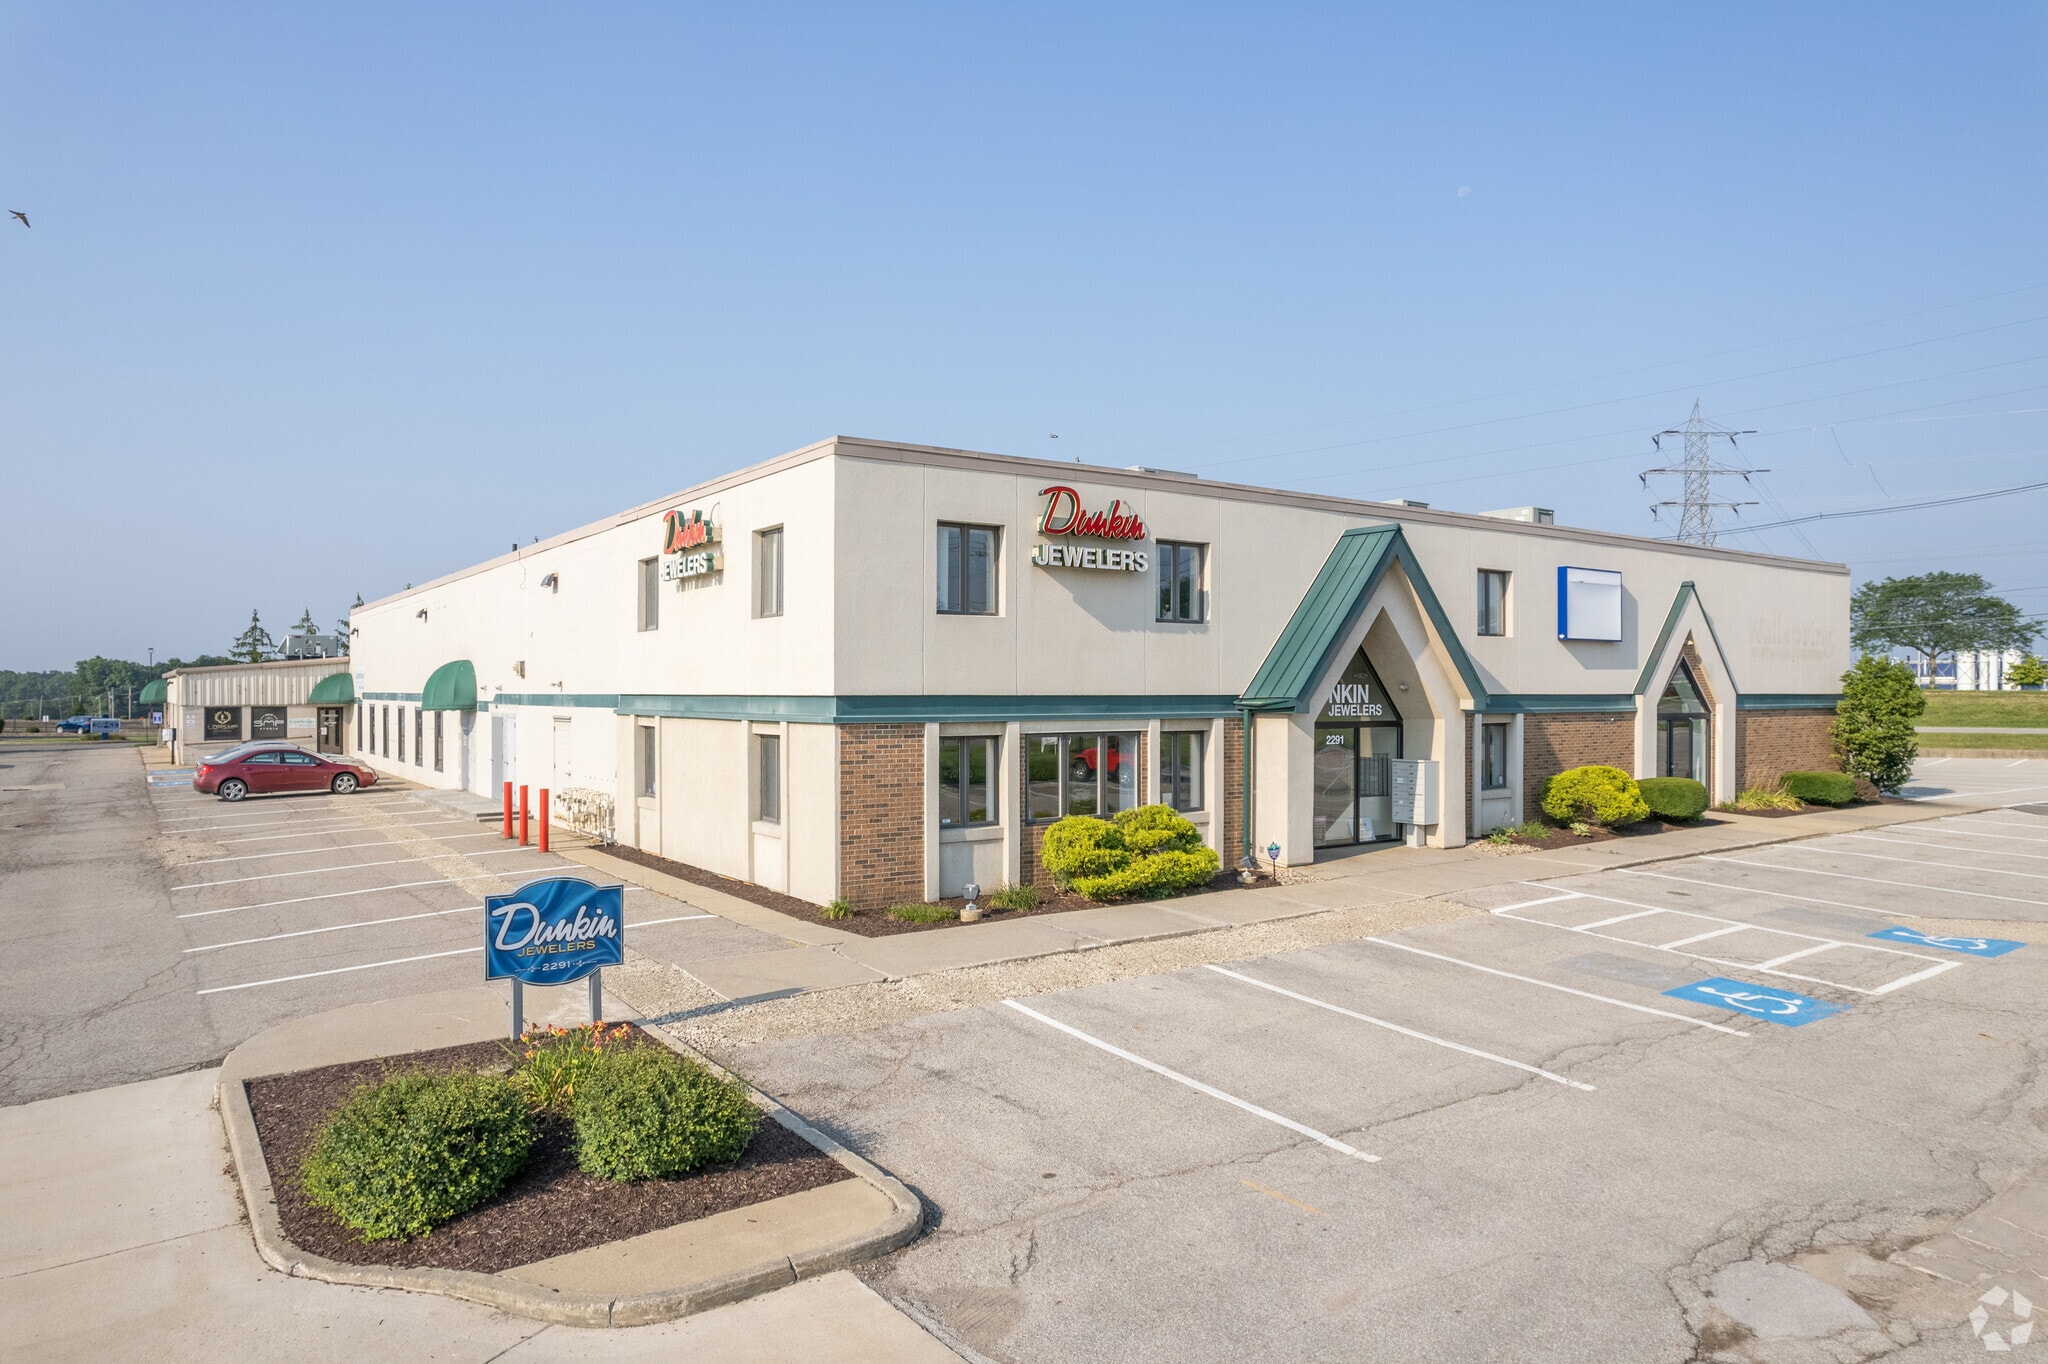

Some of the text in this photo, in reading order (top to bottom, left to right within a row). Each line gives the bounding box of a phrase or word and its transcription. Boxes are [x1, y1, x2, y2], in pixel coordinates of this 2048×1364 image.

[1043, 486, 1146, 540] Dunkin
[1036, 544, 1149, 572] JEWELERS
[1328, 684, 1369, 704] NKIN
[1328, 704, 1383, 717] JEWELERS
[1325, 735, 1344, 745] 2291
[491, 902, 618, 952] Dunkin
[517, 940, 596, 957] JEWELERS
[542, 961, 571, 971] 2291
